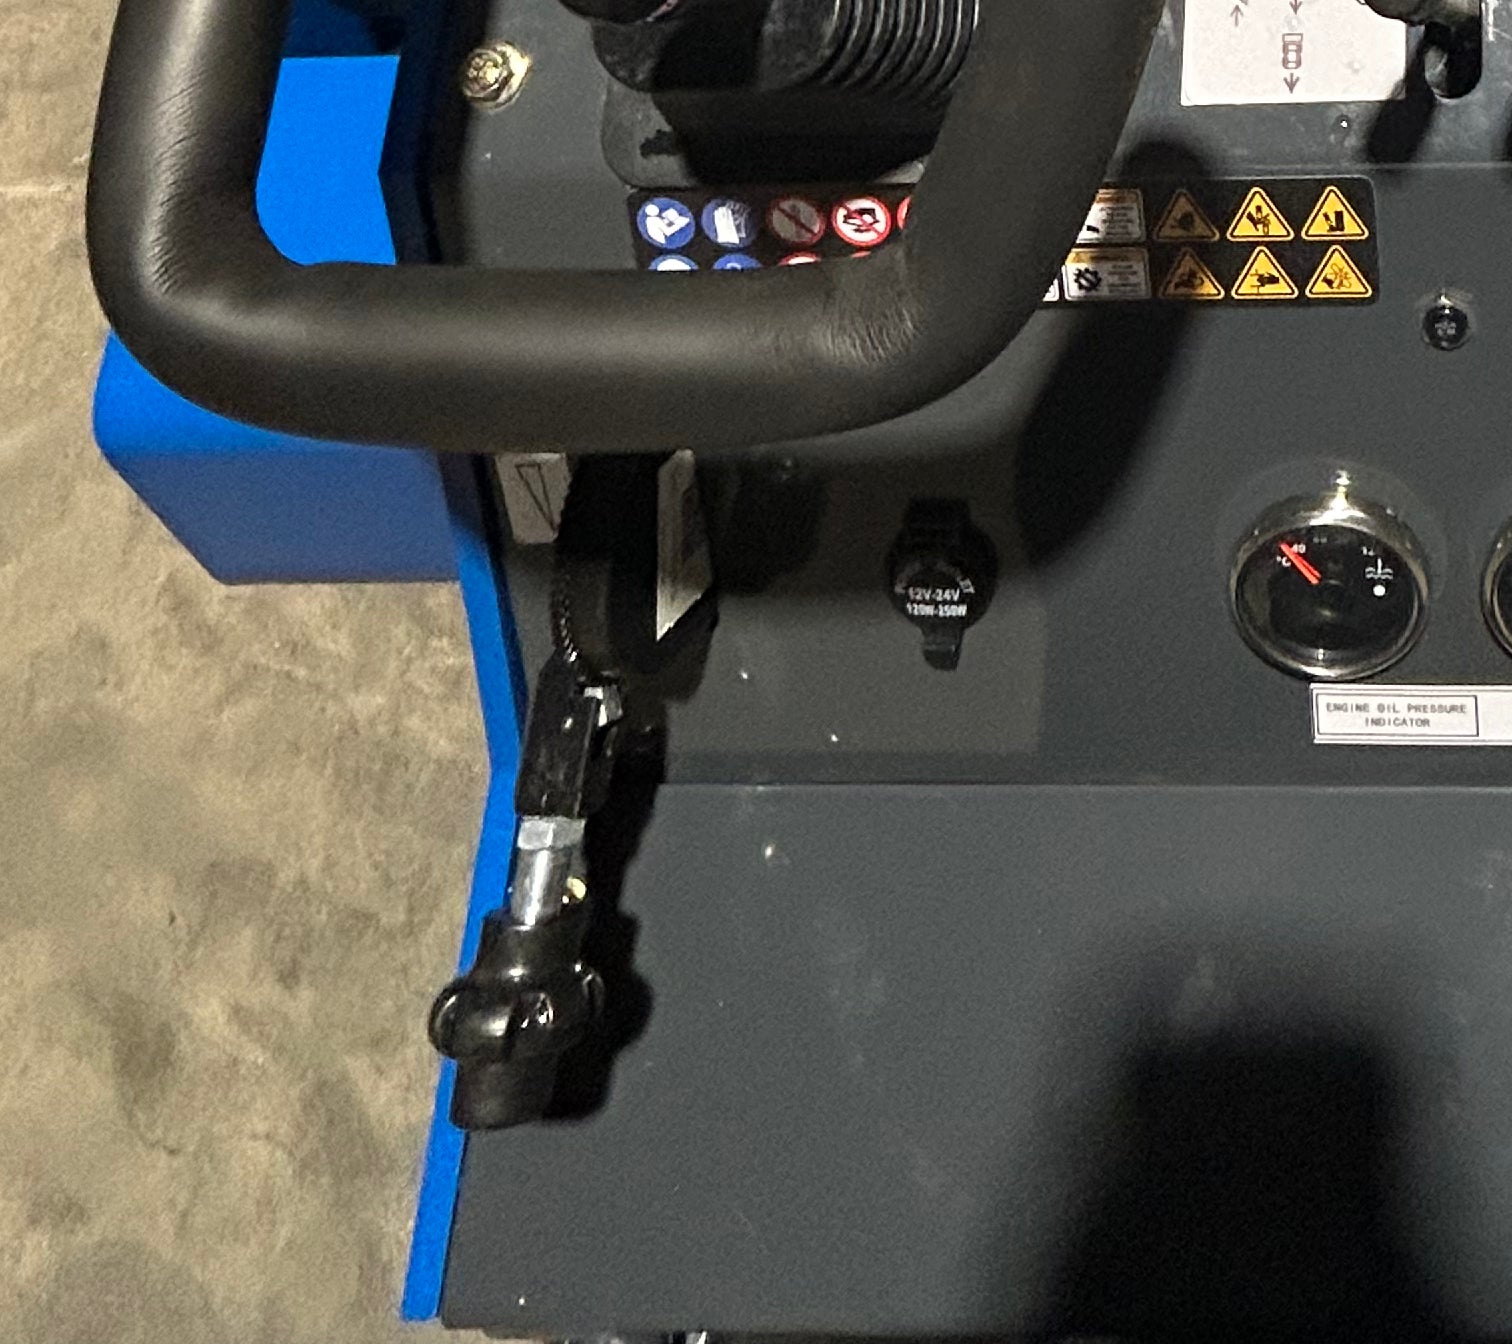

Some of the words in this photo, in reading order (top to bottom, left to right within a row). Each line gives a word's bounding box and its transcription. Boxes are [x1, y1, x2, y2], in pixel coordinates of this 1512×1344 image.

[908, 587, 961, 602] 12V-24V
[1326, 702, 1370, 713] ENGINE
[1377, 703, 1400, 713] OIL
[1407, 703, 1467, 714] PRESSURE
[1365, 717, 1430, 728] INDICATOR
